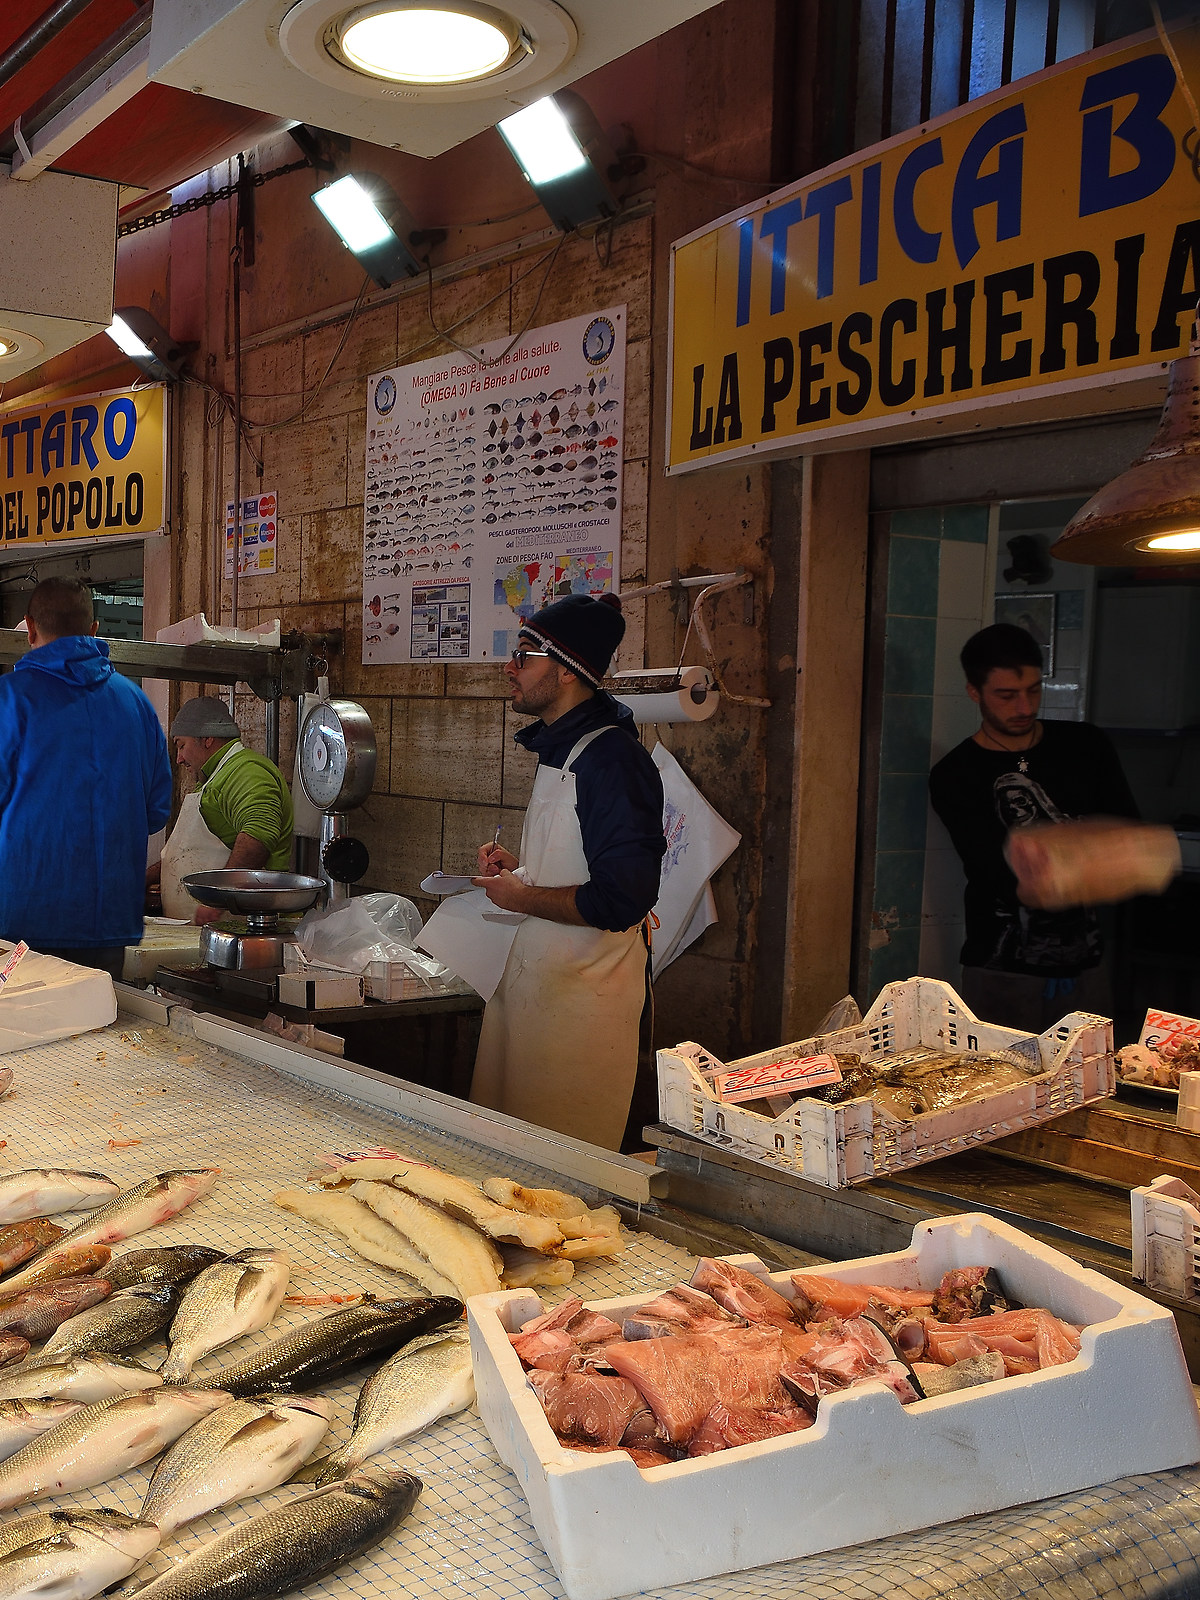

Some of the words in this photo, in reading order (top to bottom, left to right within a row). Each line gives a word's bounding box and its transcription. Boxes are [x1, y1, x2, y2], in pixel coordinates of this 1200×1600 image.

[736, 103, 1028, 328] ITTICA
[689, 352, 743, 452] LA
[760, 219, 1200, 434] PESCHERIA
[412, 370, 449, 389] Mangiare
[451, 362, 476, 379] Pesce
[489, 354, 511, 369] bene
[512, 346, 529, 362] alla
[531, 340, 562, 358] salute.
[420, 386, 457, 407] (OMEGA
[459, 382, 469, 399] 3)
[470, 379, 481, 394] Fa
[483, 375, 508, 391] Bene
[509, 368, 519, 383] al
[521, 364, 550, 381] Cuore
[37, 472, 144, 535] POPOLO
[578, 518, 610, 528] CROSTACEI
[496, 555, 512, 565] ZONE
[513, 554, 519, 563] DI
[520, 553, 540, 563] PESCA
[540, 551, 554, 560] FAO
[515, 529, 589, 548] MEDITERRANEO
[566, 545, 602, 554] MEDITERRANEO
